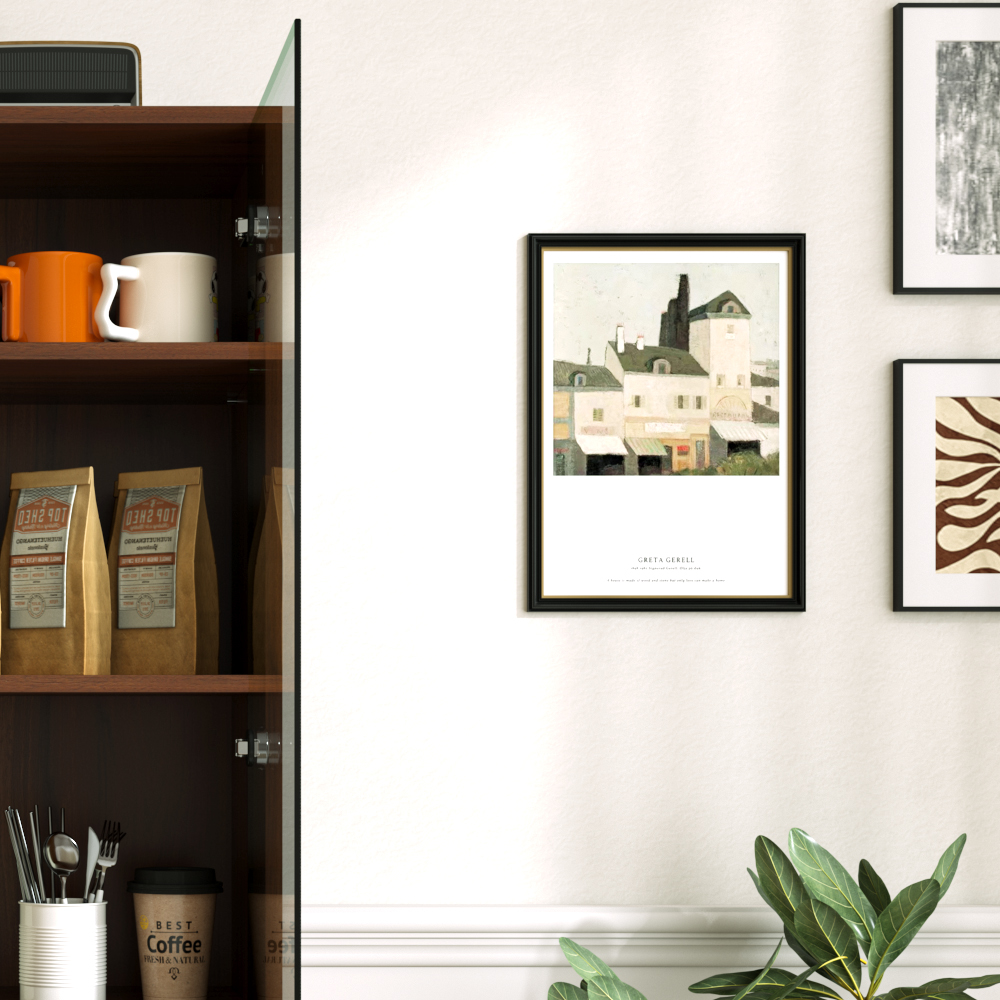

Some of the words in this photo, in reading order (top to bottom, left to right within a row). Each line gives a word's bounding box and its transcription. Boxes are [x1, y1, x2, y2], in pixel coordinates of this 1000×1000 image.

[156, 921, 192, 930] BEST
[147, 935, 202, 953] Coffee
[144, 955, 164, 964] FRESH
[166, 956, 171, 964] &
[173, 956, 206, 964] NATURAL
